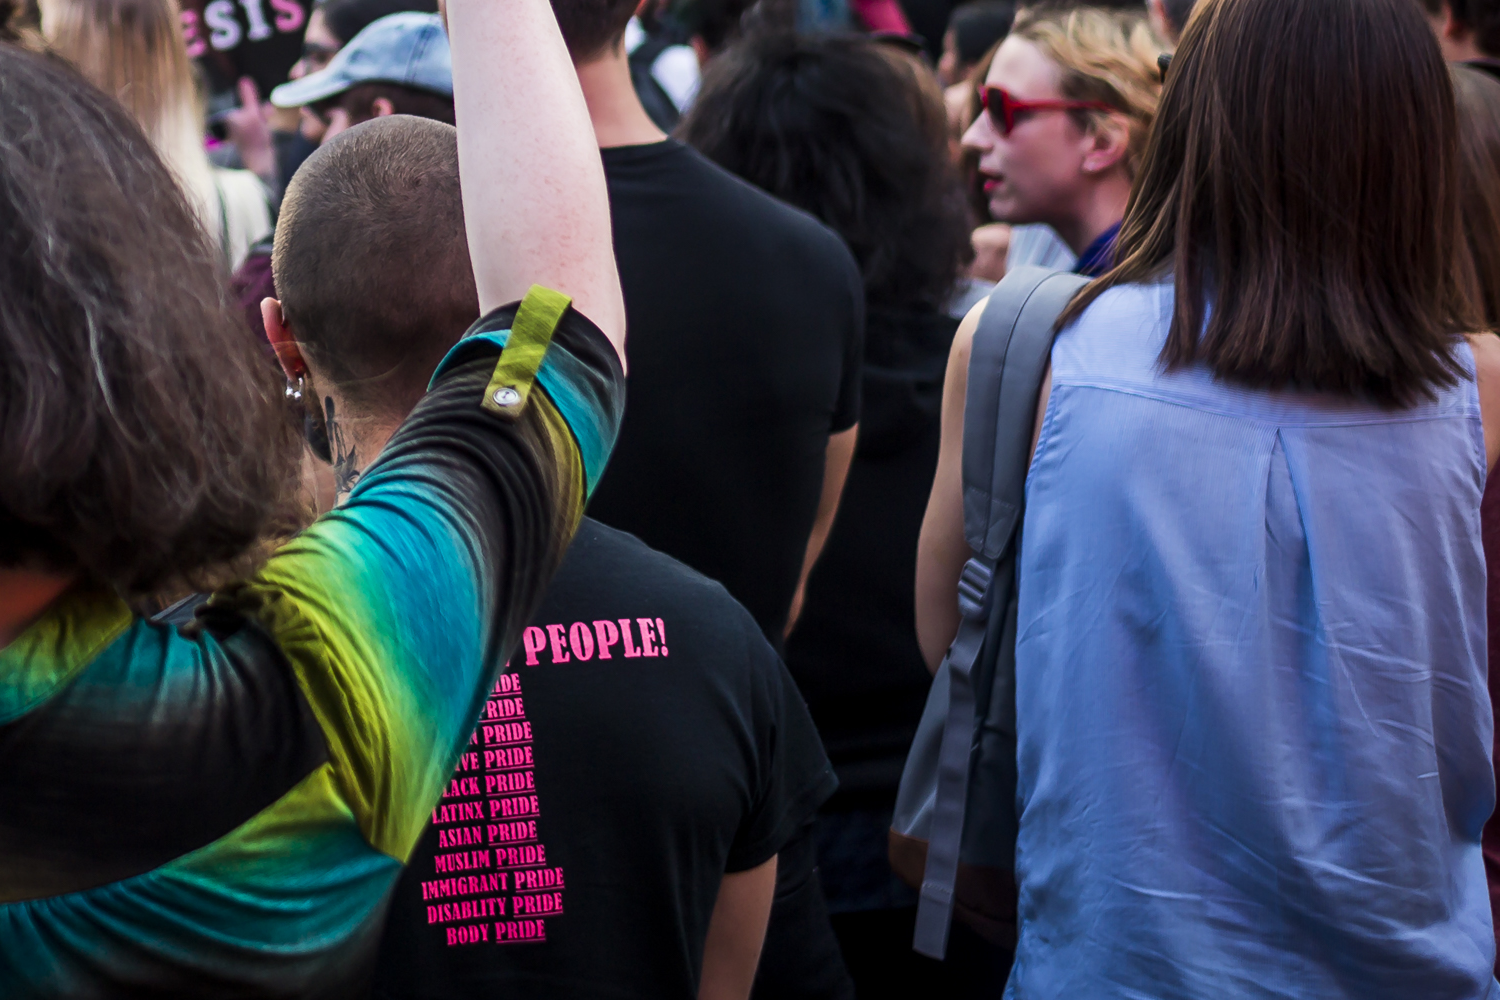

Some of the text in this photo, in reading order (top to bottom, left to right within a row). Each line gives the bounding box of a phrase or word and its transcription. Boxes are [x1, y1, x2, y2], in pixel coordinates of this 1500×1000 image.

[523, 617, 669, 666] PEOPLE!
[479, 698, 525, 719] RIDE
[482, 721, 533, 744] PRIDE
[484, 746, 534, 768] PRIDE
[443, 771, 535, 798] LACK PRIDE
[432, 795, 540, 824] LATINX PRIDE
[439, 820, 538, 848] ASIAN PRIDE
[434, 844, 546, 873] MUSLIM PRIDE
[421, 867, 564, 900] IMMIGRANT PRIDE
[427, 892, 563, 924] DISABLITY PRIDE
[446, 919, 546, 946] BODY PRIDE
